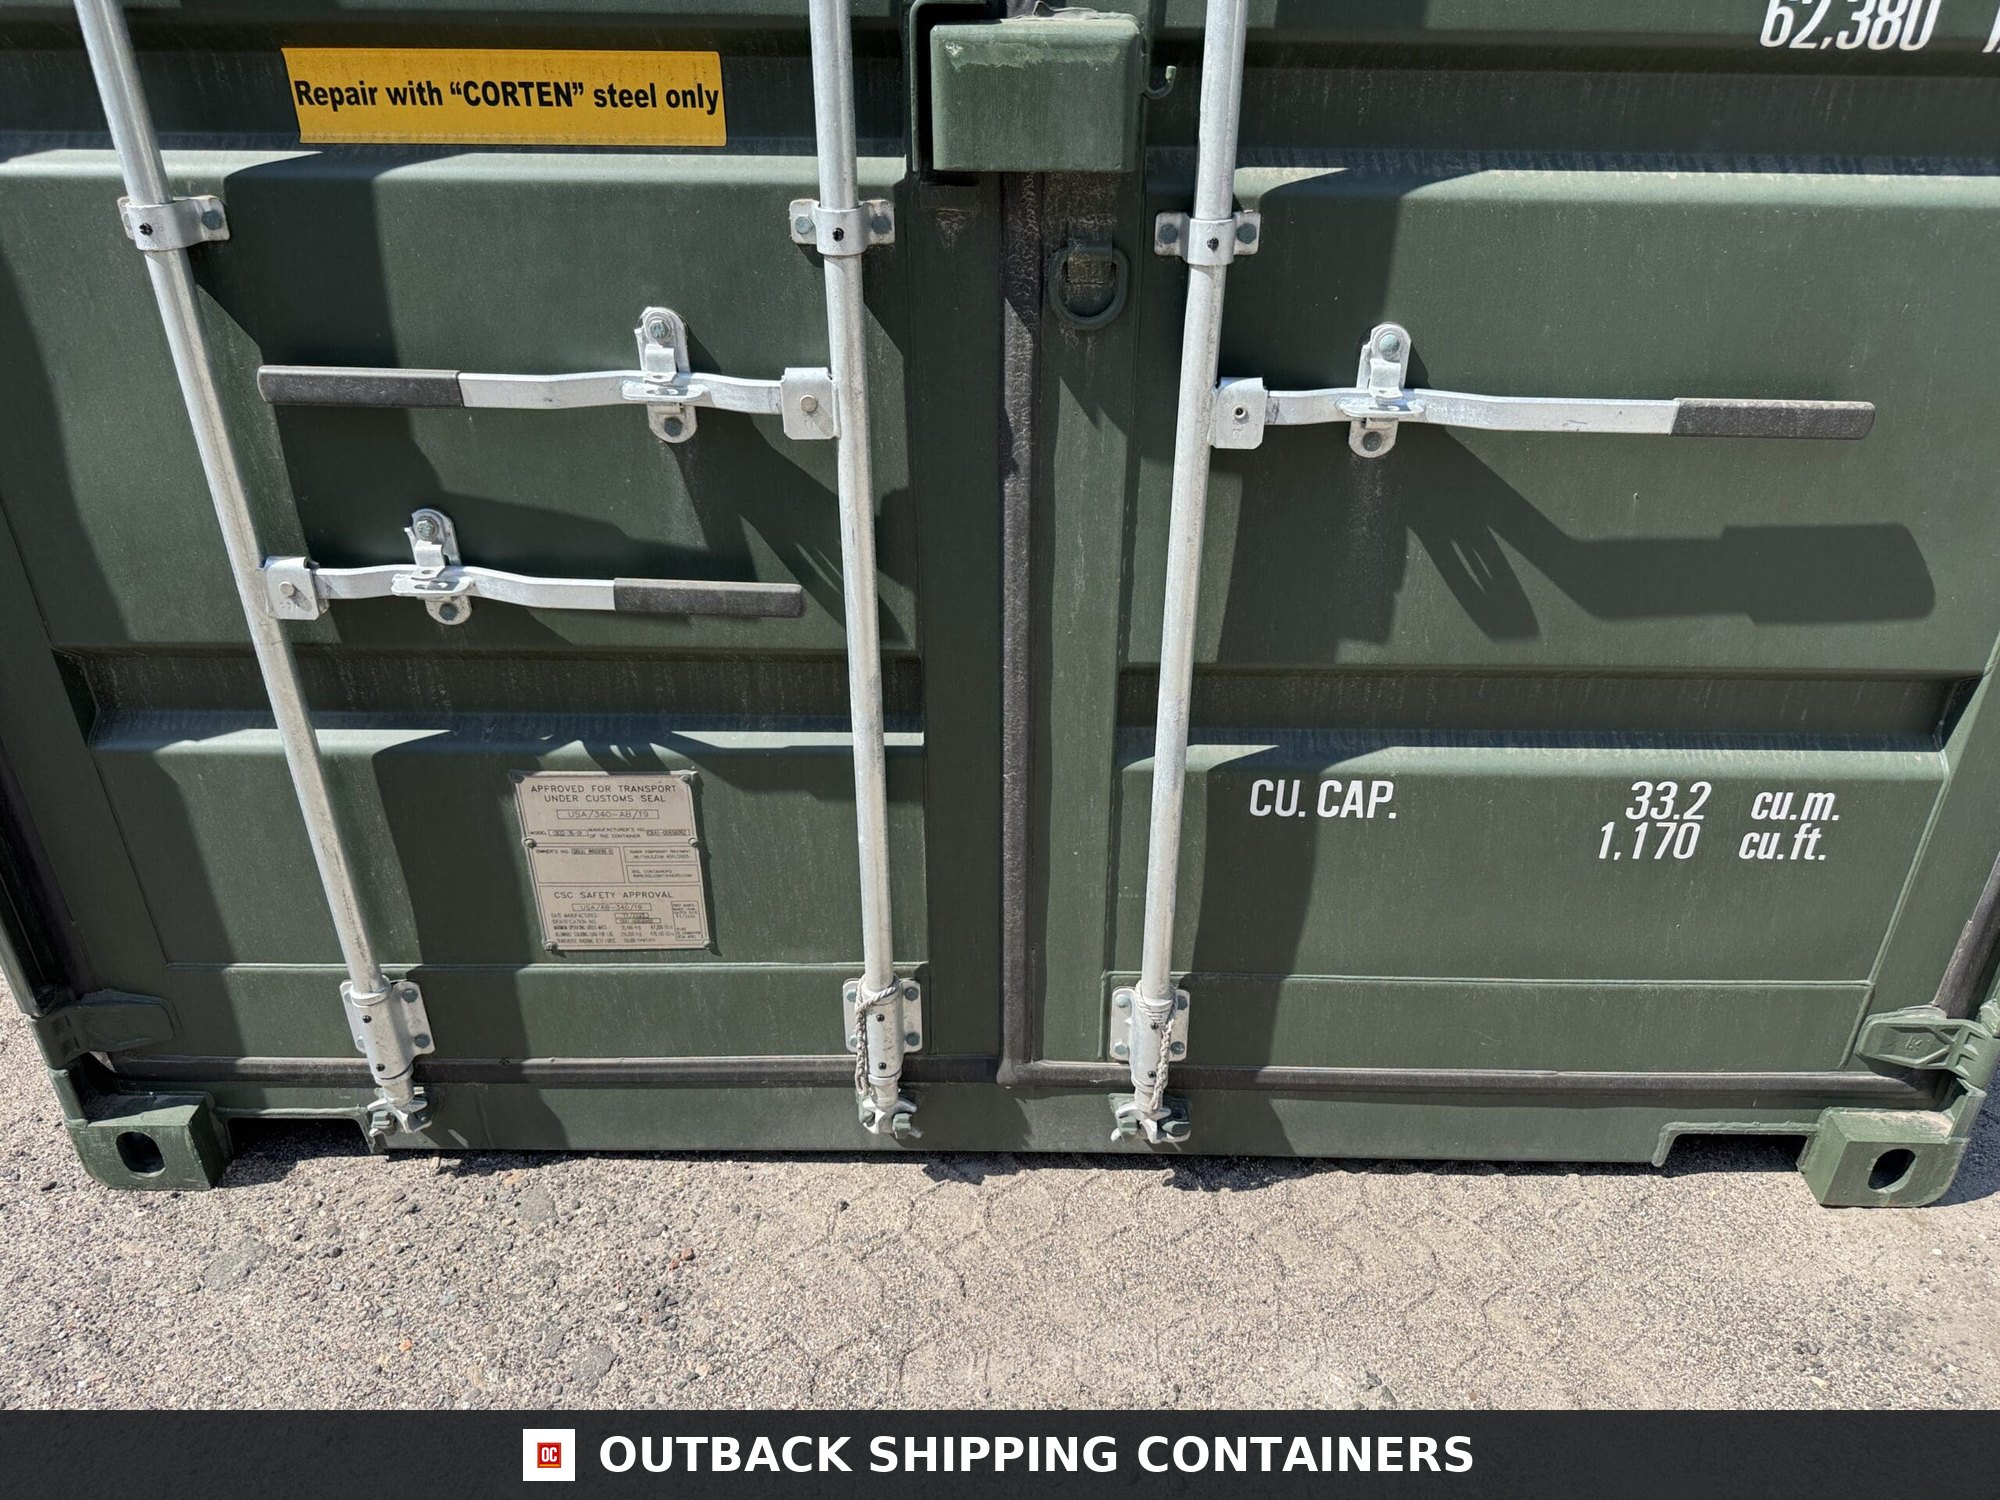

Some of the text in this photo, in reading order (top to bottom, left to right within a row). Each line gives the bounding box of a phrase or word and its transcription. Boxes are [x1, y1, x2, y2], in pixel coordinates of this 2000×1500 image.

[293, 80, 719, 116] Repair with “CORTEN” steel only
[531, 785, 677, 793] APPROVED FOR TRANSPORT
[544, 795, 666, 803] UNDER CUSTOMS SEAL
[1249, 779, 1840, 821] CU. CAP. 33.2 cu.m.
[1599, 822, 1827, 861] 1,170 cu.ft.
[554, 891, 673, 899] CSC SAFETY APPROVAL
